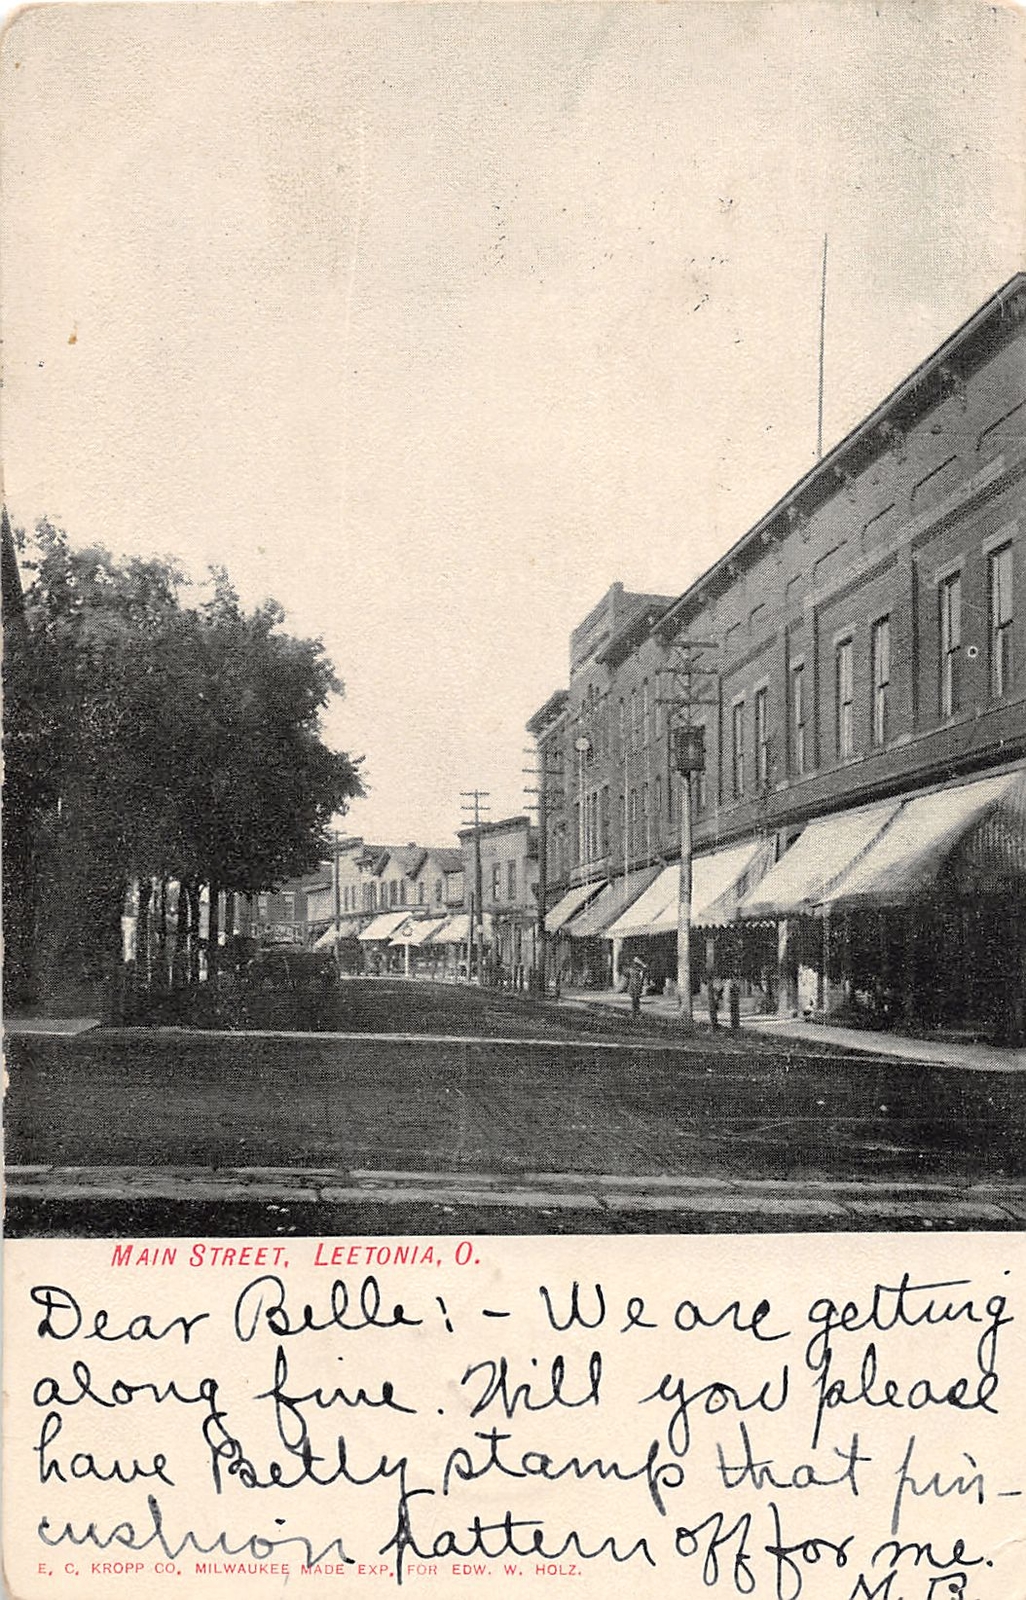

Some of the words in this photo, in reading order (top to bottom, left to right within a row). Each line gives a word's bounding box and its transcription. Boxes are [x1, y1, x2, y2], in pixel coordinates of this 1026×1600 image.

[31, 1285, 210, 1345] Dear
[539, 1281, 658, 1333] We
[674, 1299, 791, 1342] are
[805, 1270, 1015, 1372] getting
[33, 1360, 234, 1456] along
[460, 1350, 602, 1419] Will
[638, 1364, 789, 1457] you
[811, 1342, 999, 1450] please
[33, 1410, 175, 1487] have
[443, 1426, 685, 1517] stamp
[716, 1421, 872, 1497] that
[37, 1494, 356, 1568] cushion
[379, 1494, 656, 1586] pattern
[675, 1501, 756, 1594] off
[764, 1502, 855, 1600] for
[871, 1538, 994, 1569] me.
